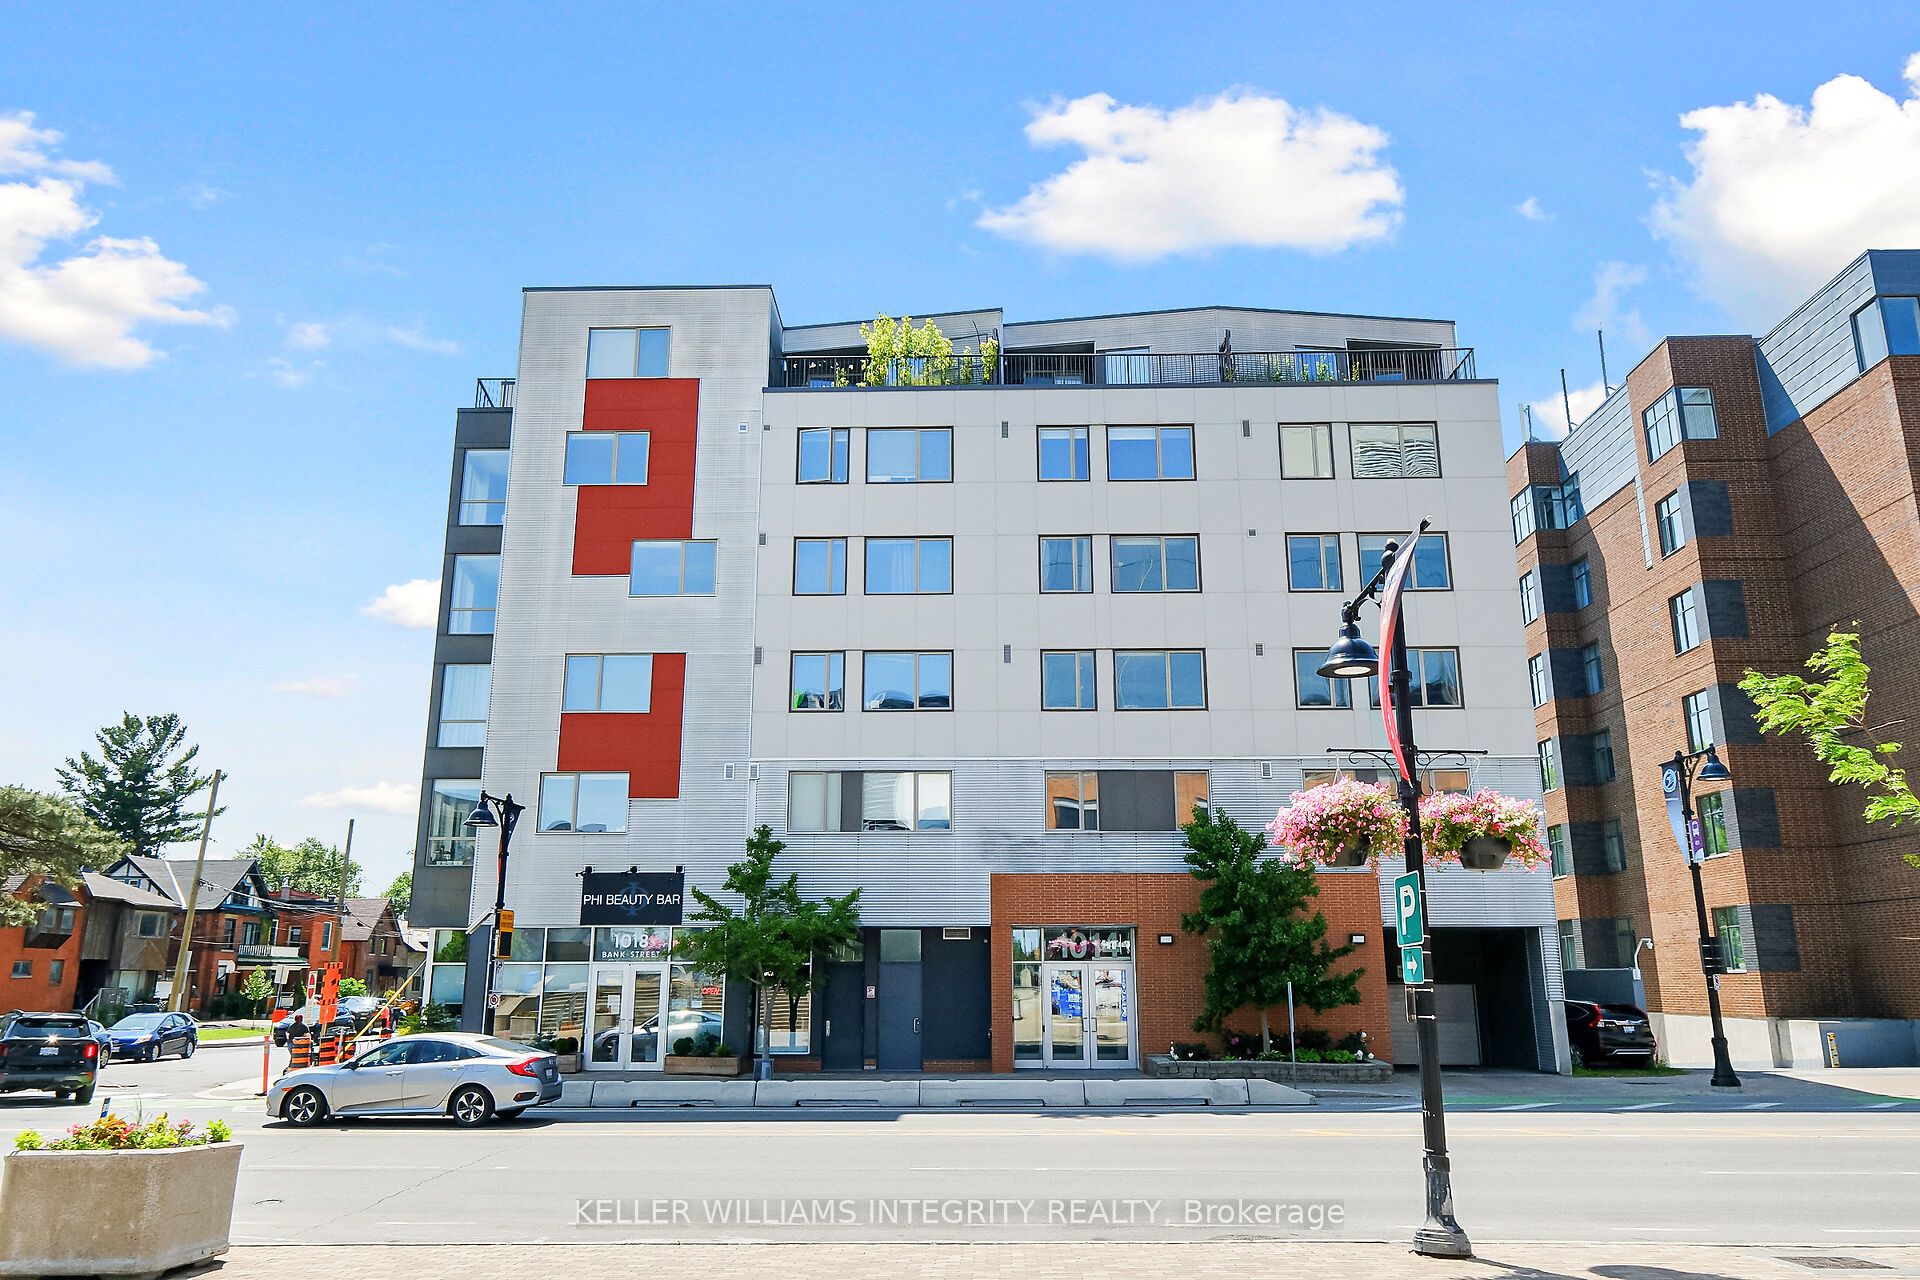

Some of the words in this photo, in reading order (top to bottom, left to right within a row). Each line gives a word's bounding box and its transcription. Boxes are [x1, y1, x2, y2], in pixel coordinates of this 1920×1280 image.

[583, 894, 603, 906] PHI
[606, 894, 654, 906] BEAUTY
[656, 894, 681, 906] BAR
[1400, 885, 1415, 935] P
[614, 933, 649, 949] 1018
[601, 951, 626, 959] BANK
[631, 951, 660, 959] STREET
